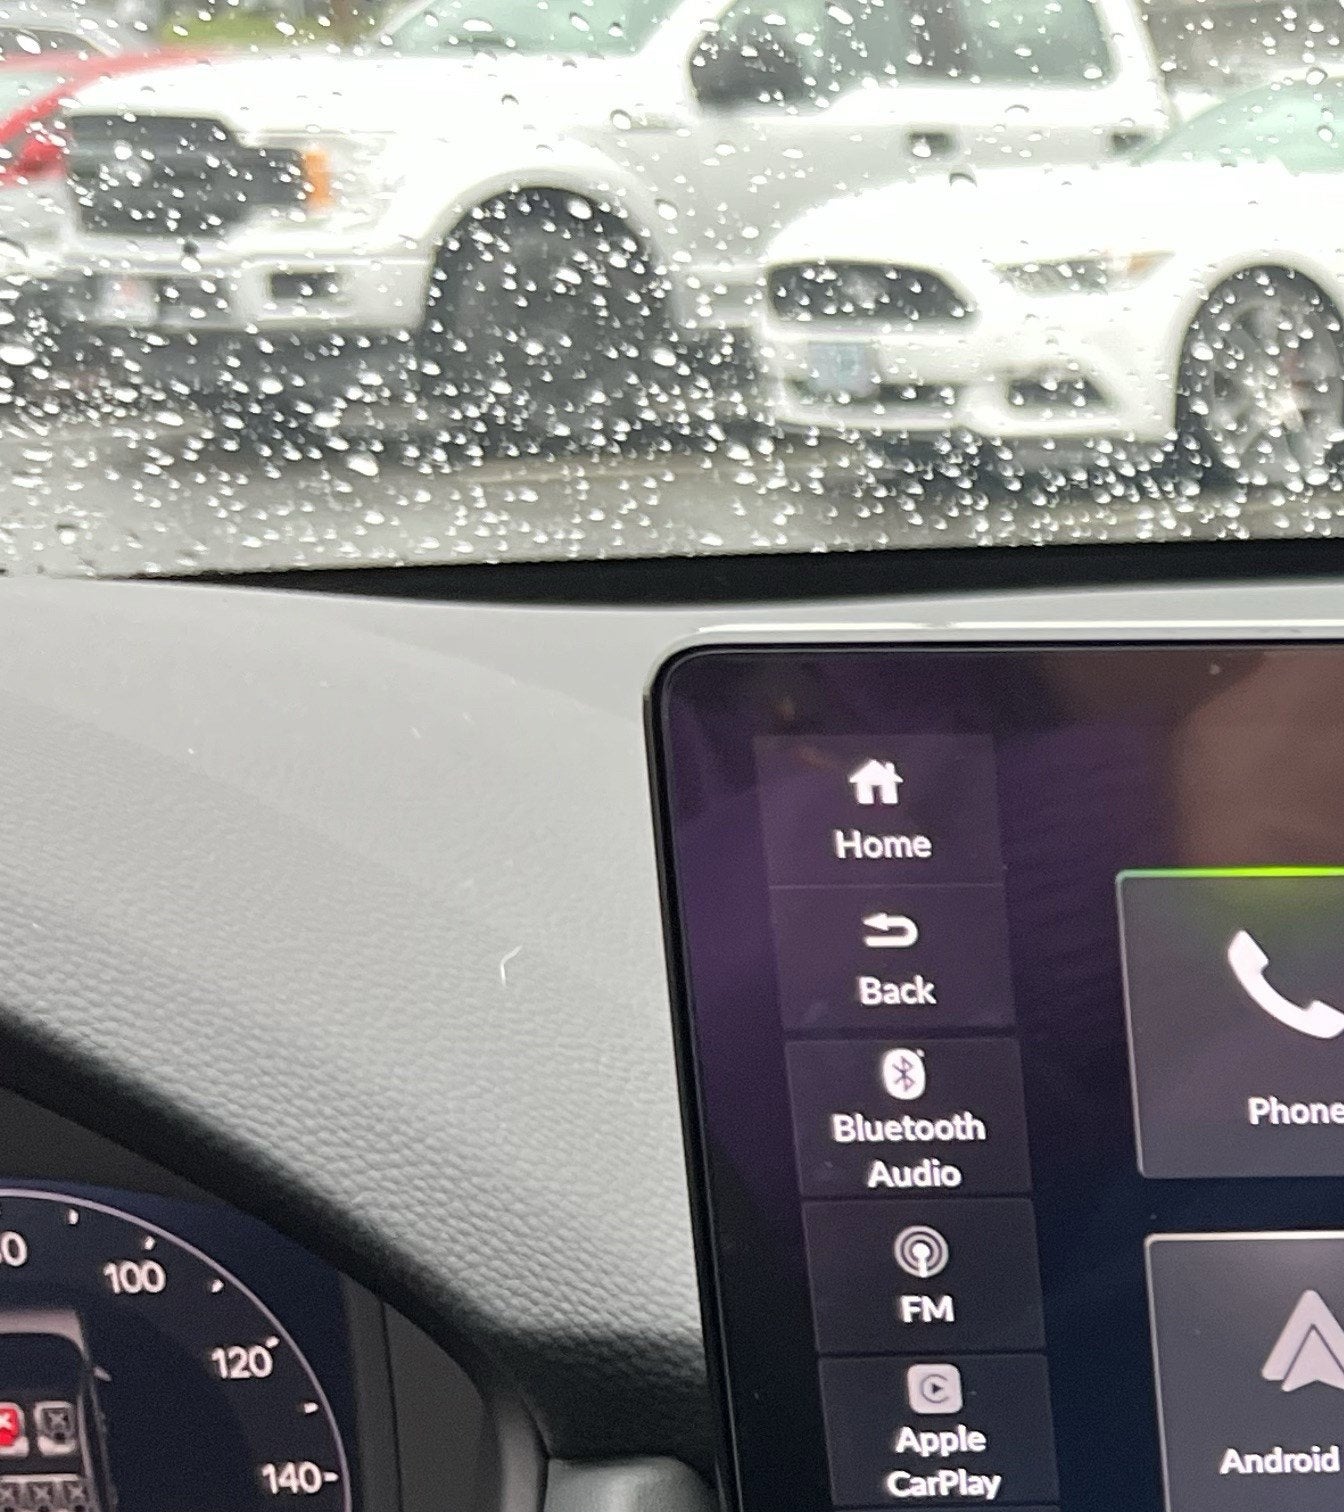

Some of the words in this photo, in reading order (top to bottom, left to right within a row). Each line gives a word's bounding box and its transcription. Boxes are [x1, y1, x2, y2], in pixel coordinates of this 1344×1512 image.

[834, 829, 932, 859] Home
[858, 974, 937, 1006] Back
[831, 1111, 986, 1143] Bluetooth
[867, 1158, 962, 1188] Audio
[0, 1231, 27, 1267] 0
[103, 1260, 166, 1294] 100
[899, 1295, 955, 1323] FM
[210, 1345, 274, 1379] 120
[894, 1424, 987, 1458] Apple
[1219, 1445, 1341, 1475] Android
[262, 1461, 323, 1494] 140
[885, 1468, 1002, 1500] CarPlay
